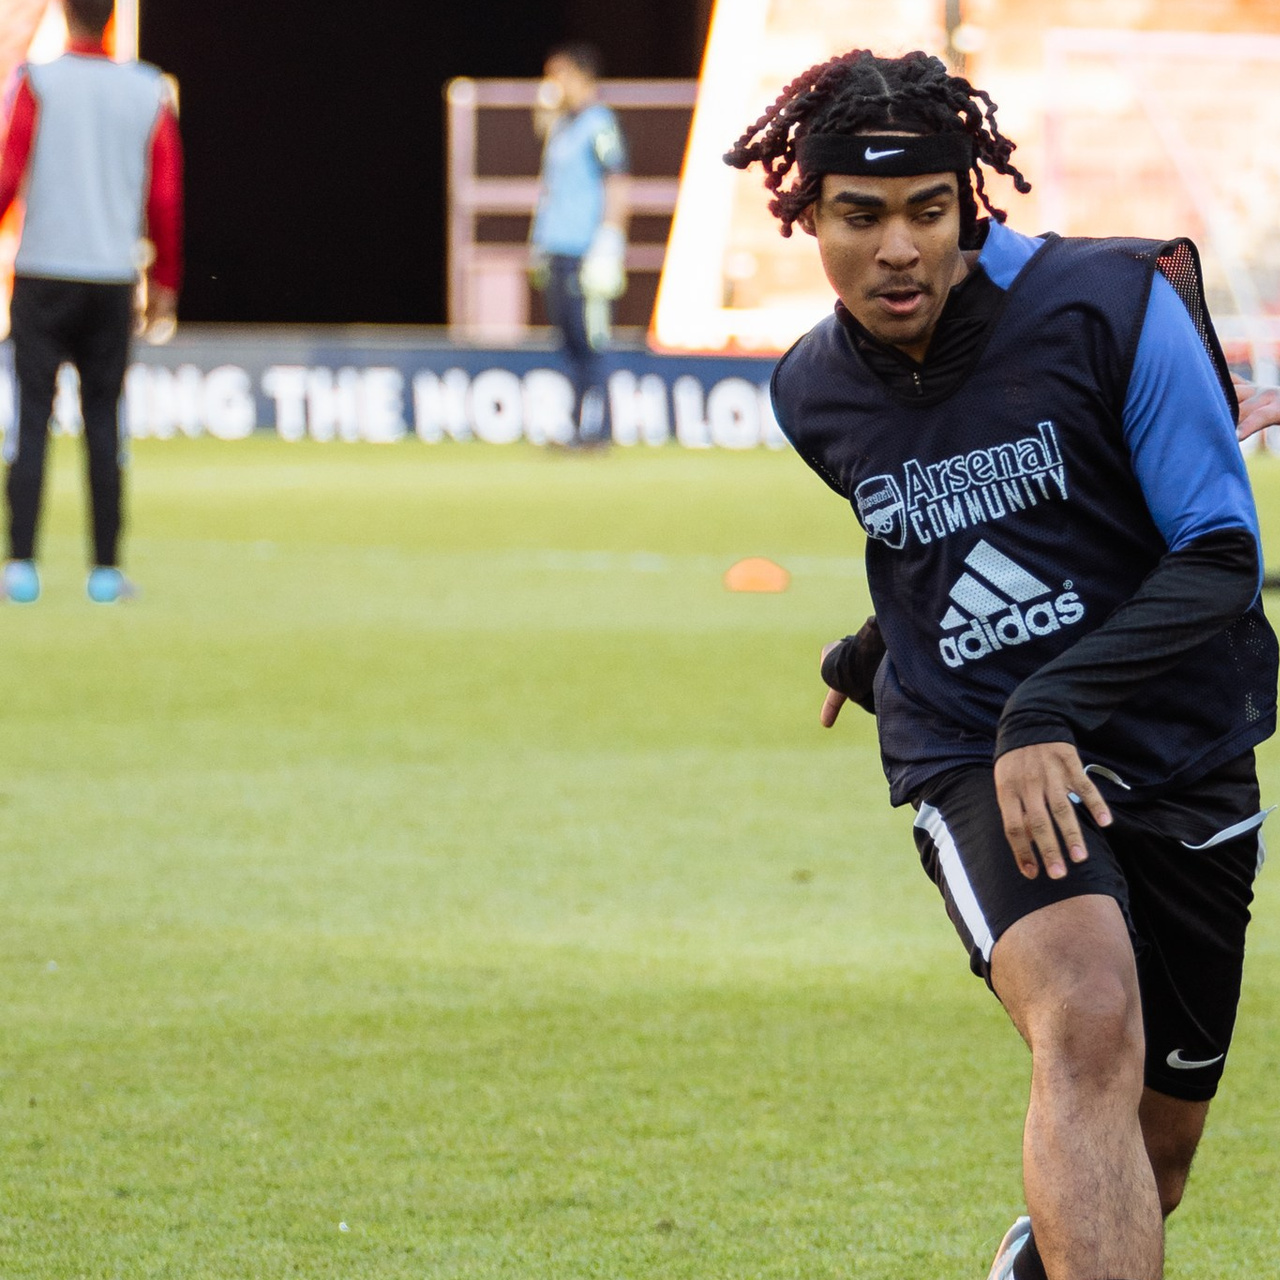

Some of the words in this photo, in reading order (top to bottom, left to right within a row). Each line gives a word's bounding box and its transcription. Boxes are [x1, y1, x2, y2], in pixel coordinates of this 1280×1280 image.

[262, 365, 407, 444] THE
[902, 421, 1063, 511] Arsenal
[909, 466, 1068, 544] COMMUNITY
[938, 591, 1085, 668] adidas
